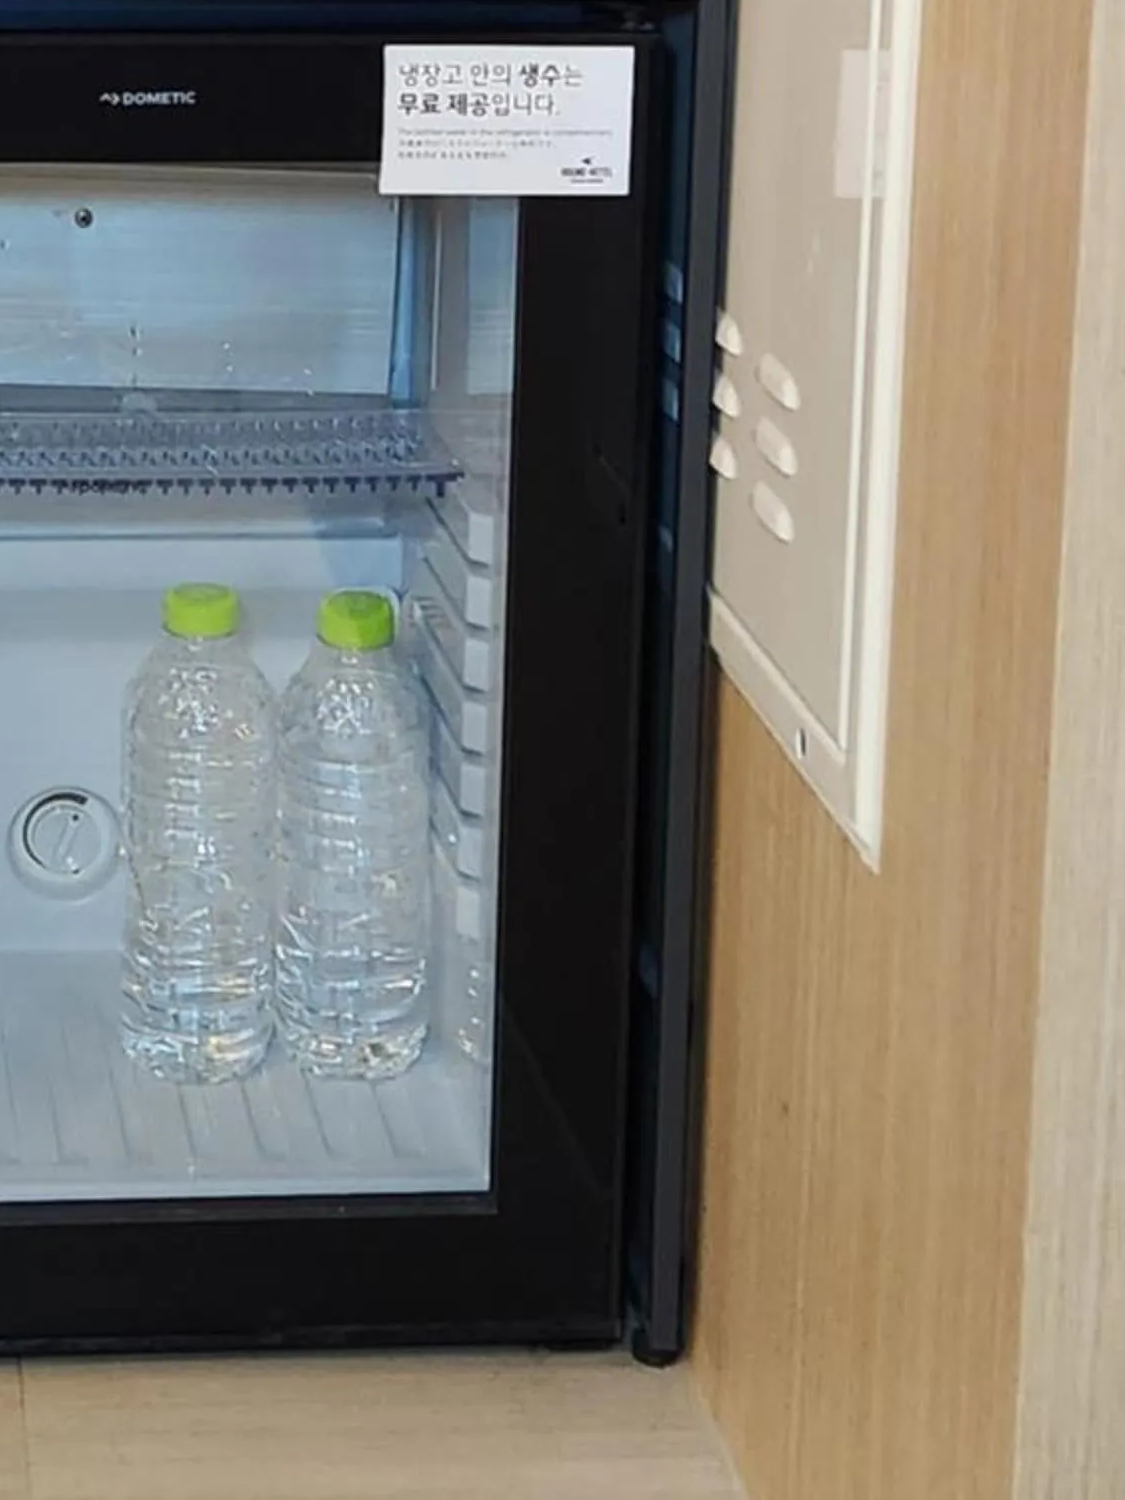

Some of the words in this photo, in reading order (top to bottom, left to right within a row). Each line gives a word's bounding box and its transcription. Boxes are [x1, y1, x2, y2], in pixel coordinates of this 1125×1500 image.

[398, 63, 463, 88] 냉장고
[469, 62, 512, 88] 안의
[520, 62, 583, 88] 생수는
[122, 91, 196, 105] DOMETIC
[397, 92, 442, 116] 무료
[446, 92, 562, 117] 제공입니다.
